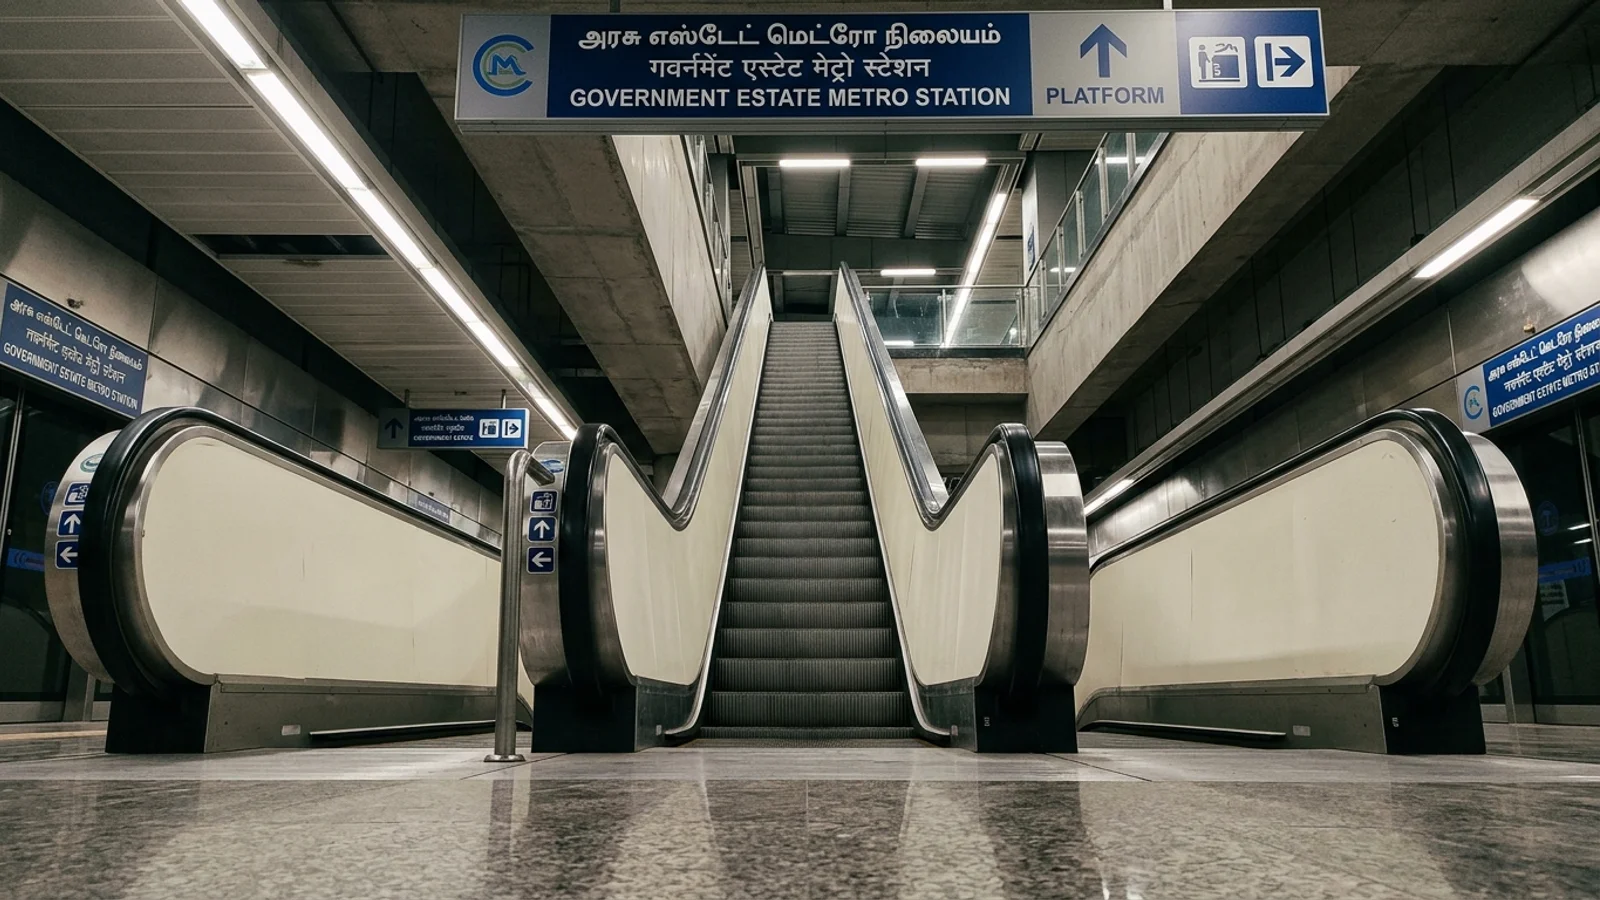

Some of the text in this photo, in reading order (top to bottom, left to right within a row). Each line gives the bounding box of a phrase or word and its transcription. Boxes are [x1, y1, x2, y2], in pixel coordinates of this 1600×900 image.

[578, 22, 1001, 52] அரசு எஸ்டேட் மெட்ரோ நிலையம்
[649, 51, 931, 83] गवर्नमेंट एस्टेट मेट्रो स्टेशन
[570, 86, 1010, 108] GOVERNMENT ESTATE METRO STATION
[1046, 86, 1165, 105] PLATFORM
[4, 342, 59, 375] GOVERNMENT
